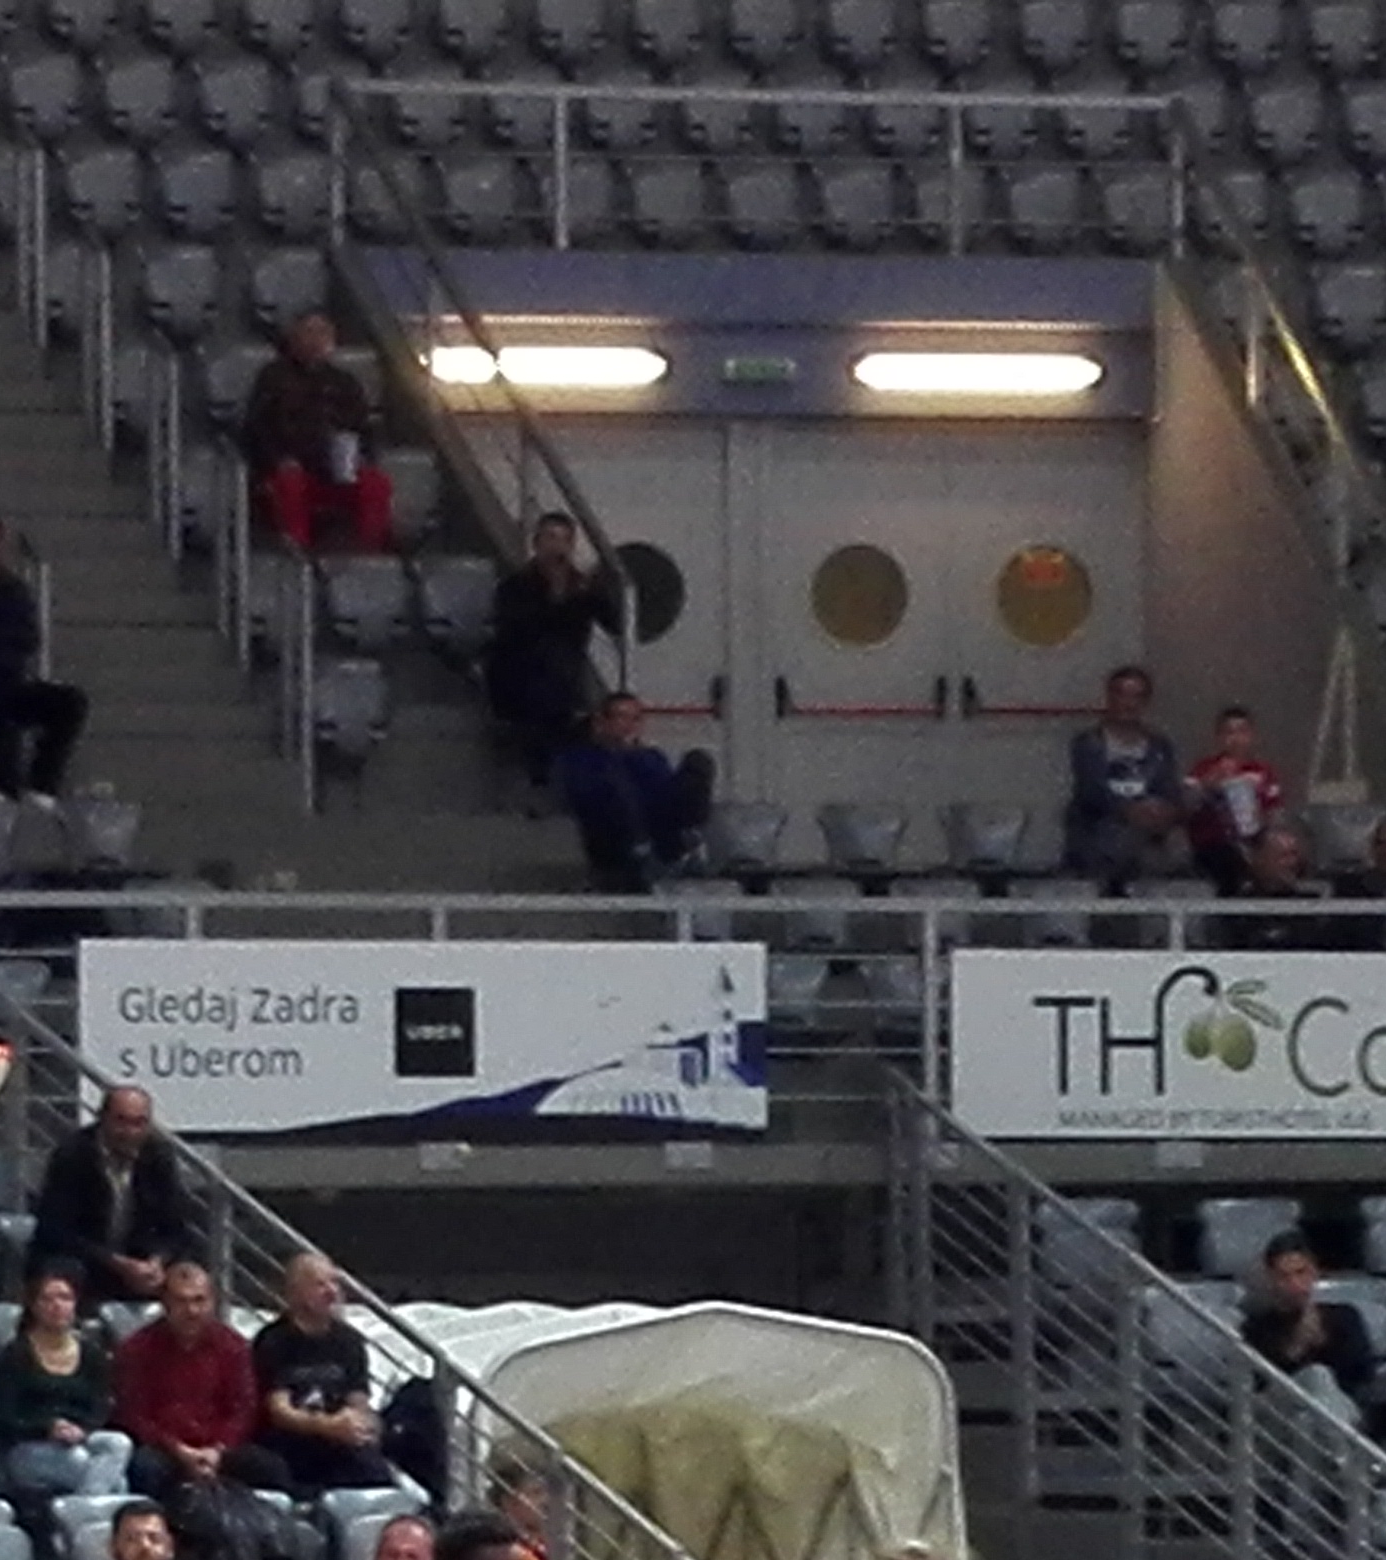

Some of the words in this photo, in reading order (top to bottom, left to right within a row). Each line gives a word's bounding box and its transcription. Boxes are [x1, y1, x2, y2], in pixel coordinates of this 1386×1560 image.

[119, 988, 236, 1031] Gledaj
[251, 988, 360, 1024] Zadra
[119, 1046, 136, 1076] s
[149, 1044, 303, 1077] Uberom
